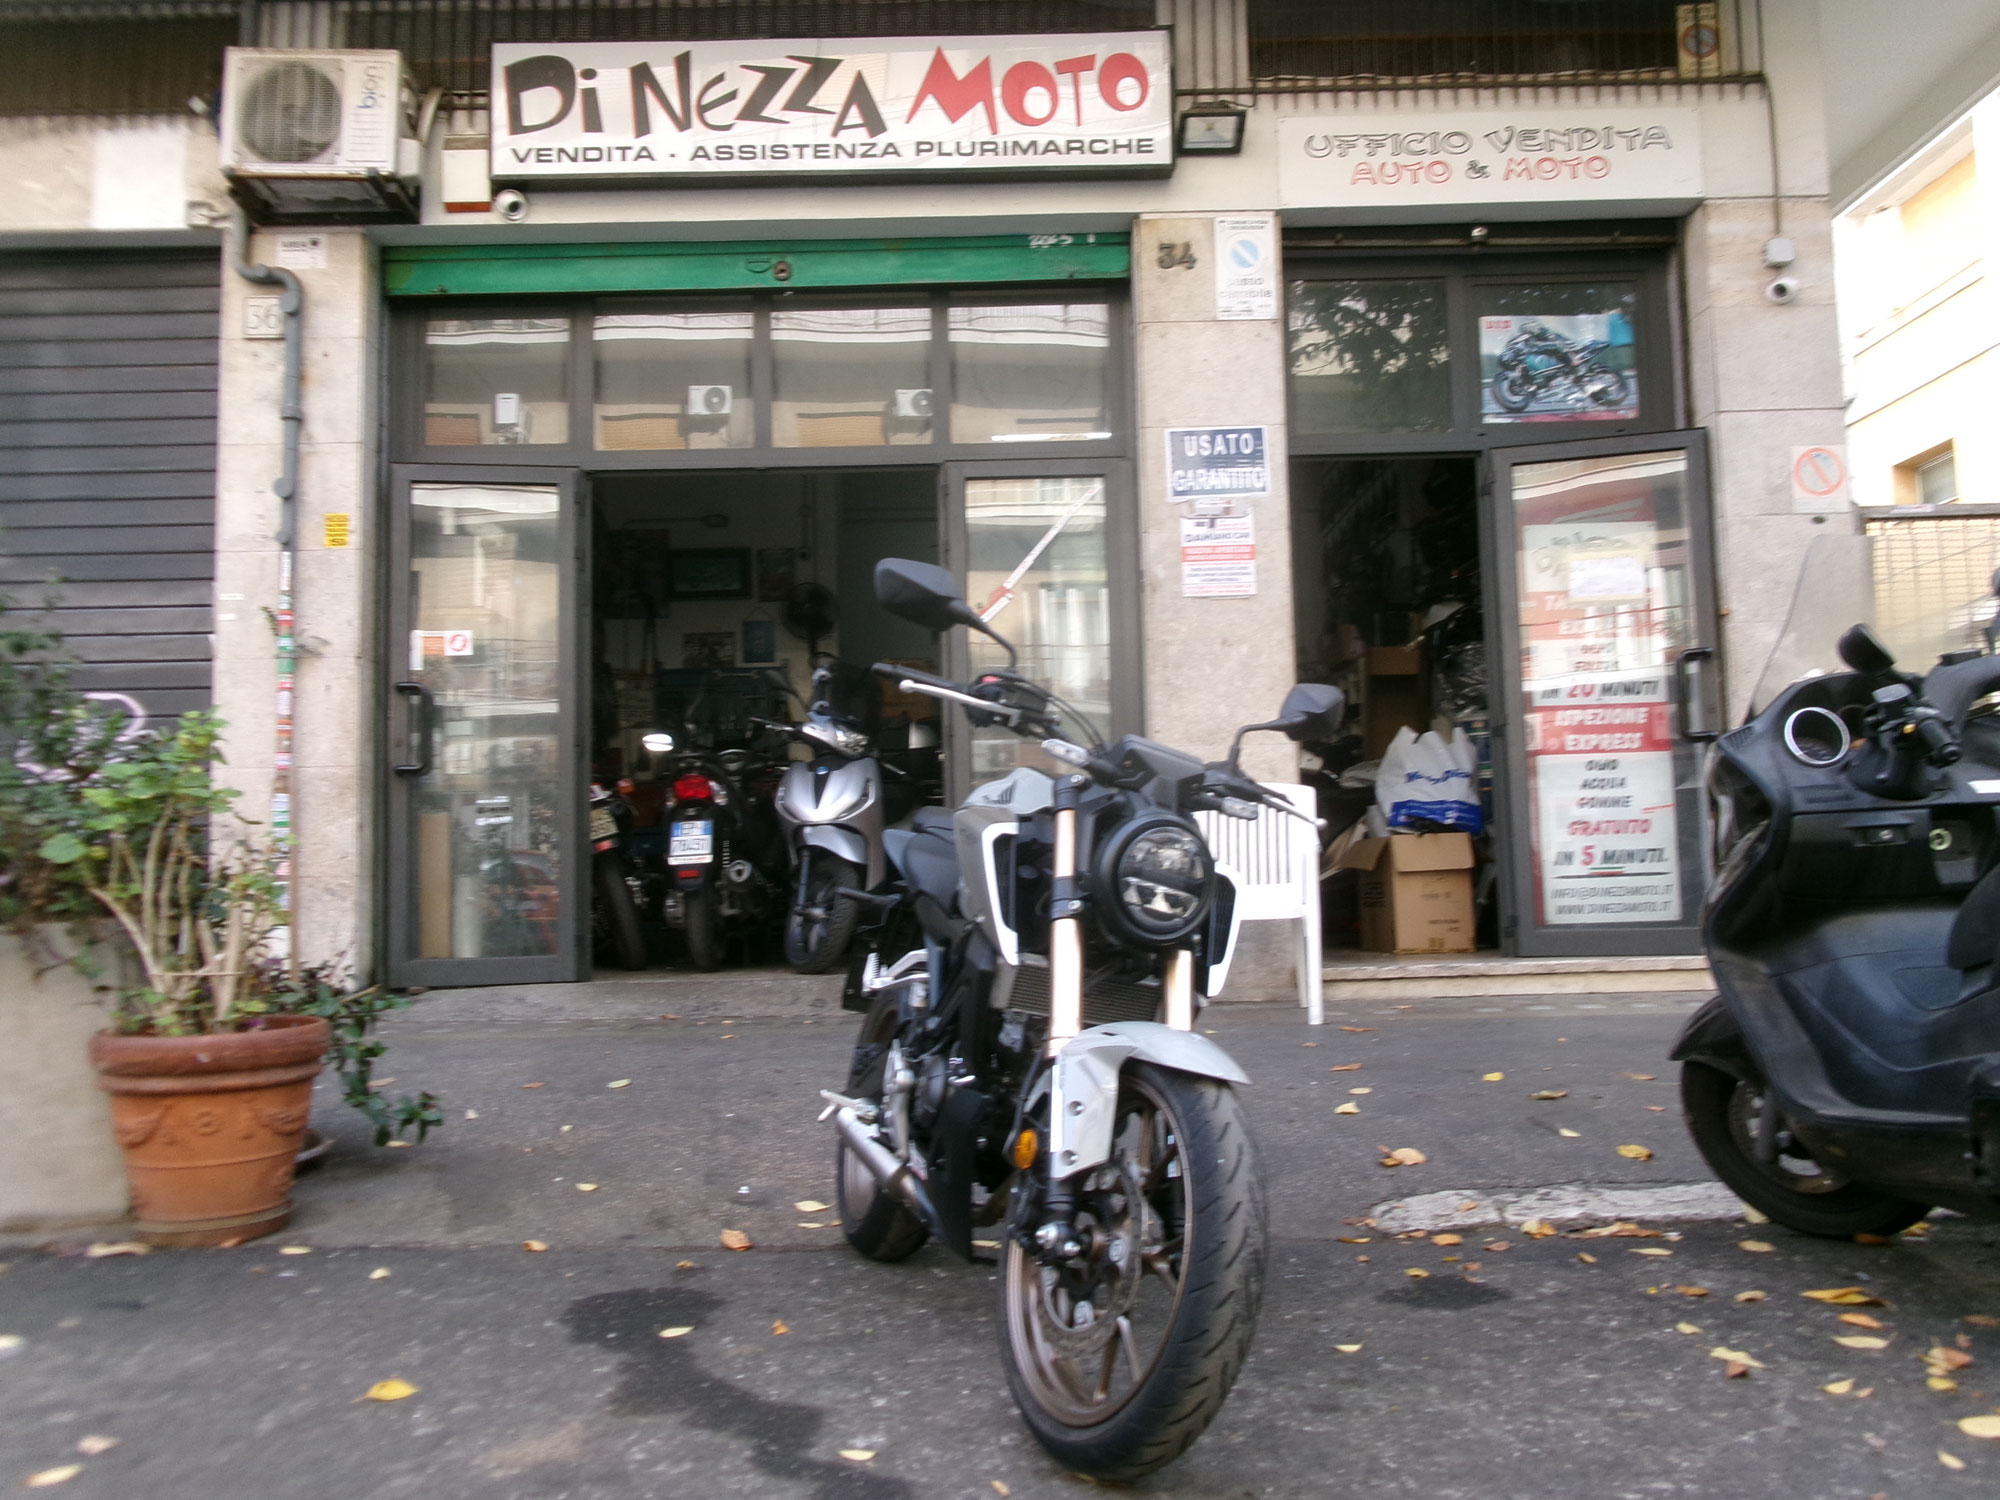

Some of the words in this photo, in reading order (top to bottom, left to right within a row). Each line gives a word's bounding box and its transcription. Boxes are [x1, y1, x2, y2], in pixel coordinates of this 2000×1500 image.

[503, 54, 603, 136] Di
[904, 45, 1149, 136] MOTO
[510, 144, 656, 164] VENDITA
[689, 141, 902, 162] ASSISTENZA
[914, 137, 1155, 158] PLURIMARCHE
[1303, 130, 1474, 159] UFFICIO
[1482, 125, 1673, 153] VENDITA
[1350, 159, 1453, 186] AUTO
[1463, 159, 1491, 180] &
[1502, 155, 1612, 182] MOTO
[1158, 242, 1198, 270] 34
[1183, 432, 1255, 457] USATO
[1172, 466, 1266, 492] GARANTITO
[1564, 731, 1644, 751] EXPRESS
[1579, 844, 1597, 867] 5
